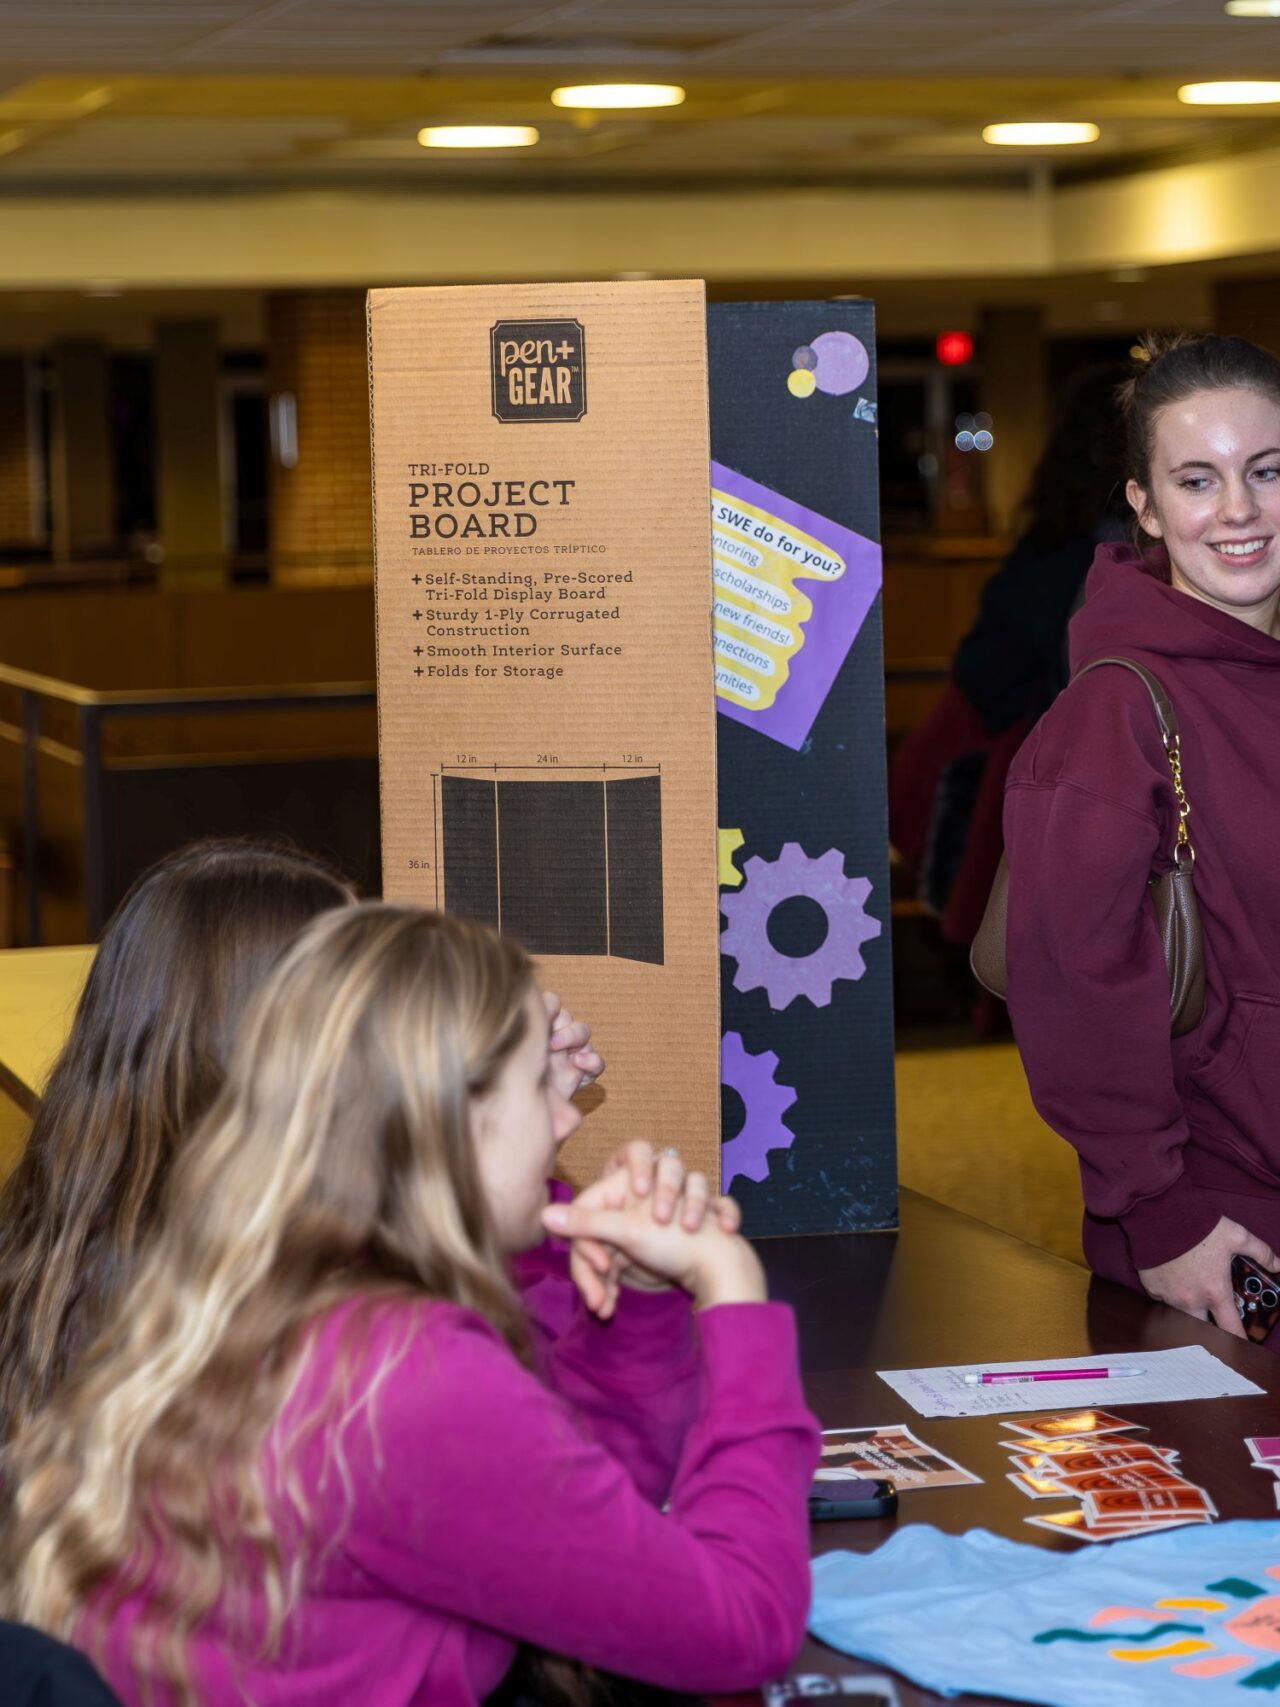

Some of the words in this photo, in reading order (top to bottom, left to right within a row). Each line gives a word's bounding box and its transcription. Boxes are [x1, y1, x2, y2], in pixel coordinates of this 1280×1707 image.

[508, 366, 572, 405] GEAR
[408, 462, 490, 477] TRI-FOLD
[408, 480, 576, 508] PROJECT
[409, 512, 538, 539] BOARD
[717, 507, 752, 532] SWE
[754, 526, 774, 542] do
[777, 535, 801, 555] for
[800, 551, 841, 575] you?
[412, 546, 462, 556] TABLERO
[466, 546, 480, 555] DE
[483, 545, 550, 555] PROYECTOS
[553, 543, 607, 554] TRÍPTICO
[425, 571, 538, 588] Self-Standing,
[543, 570, 634, 584] Pre-Scored
[425, 587, 488, 601] Tri-Fold
[493, 586, 553, 602] Display
[558, 586, 606, 600] Board
[713, 567, 790, 611] scholarships
[426, 608, 479, 624] Sturdy
[484, 607, 525, 624] 1-Ply
[529, 606, 621, 623] Corrugated
[426, 623, 530, 637] Construction
[714, 602, 741, 621] new
[742, 614, 790, 645] friends!
[427, 644, 487, 657] Smooth
[492, 643, 555, 657] Interior
[560, 642, 622, 656] Surface
[427, 664, 469, 678] Folds
[475, 664, 498, 677] for
[503, 665, 564, 680] Storage
[456, 754, 467, 763] 12
[468, 754, 477, 763] in
[536, 754, 549, 763] 24
[551, 754, 559, 763] in
[622, 754, 634, 763] 12
[635, 754, 643, 763] in
[408, 860, 420, 869] 36
[422, 860, 430, 869] in
